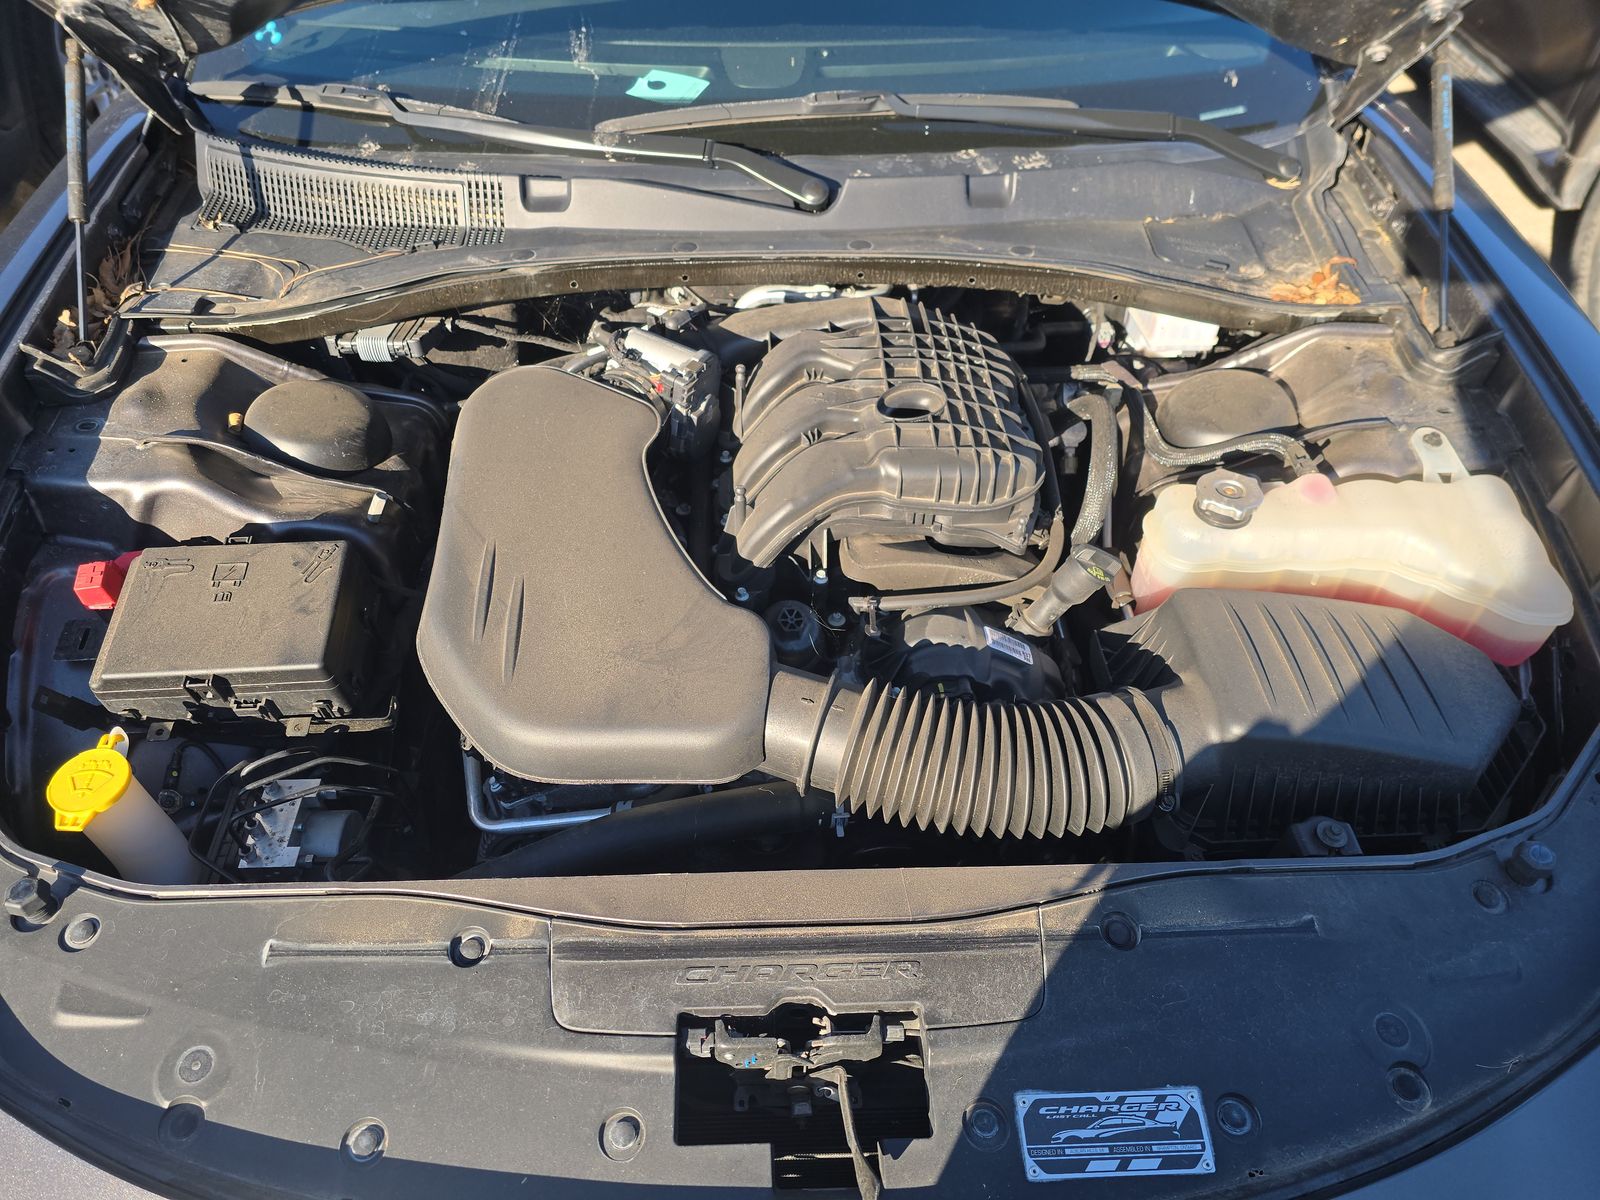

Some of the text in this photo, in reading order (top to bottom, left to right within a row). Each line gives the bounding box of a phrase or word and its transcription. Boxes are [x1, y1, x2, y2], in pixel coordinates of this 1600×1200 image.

[675, 960, 921, 986] CHARGER
[1039, 1102, 1184, 1115] CHARGER
[1030, 1148, 1057, 1156] DESIGNED
[1113, 1145, 1144, 1153] ASSEMBLED
